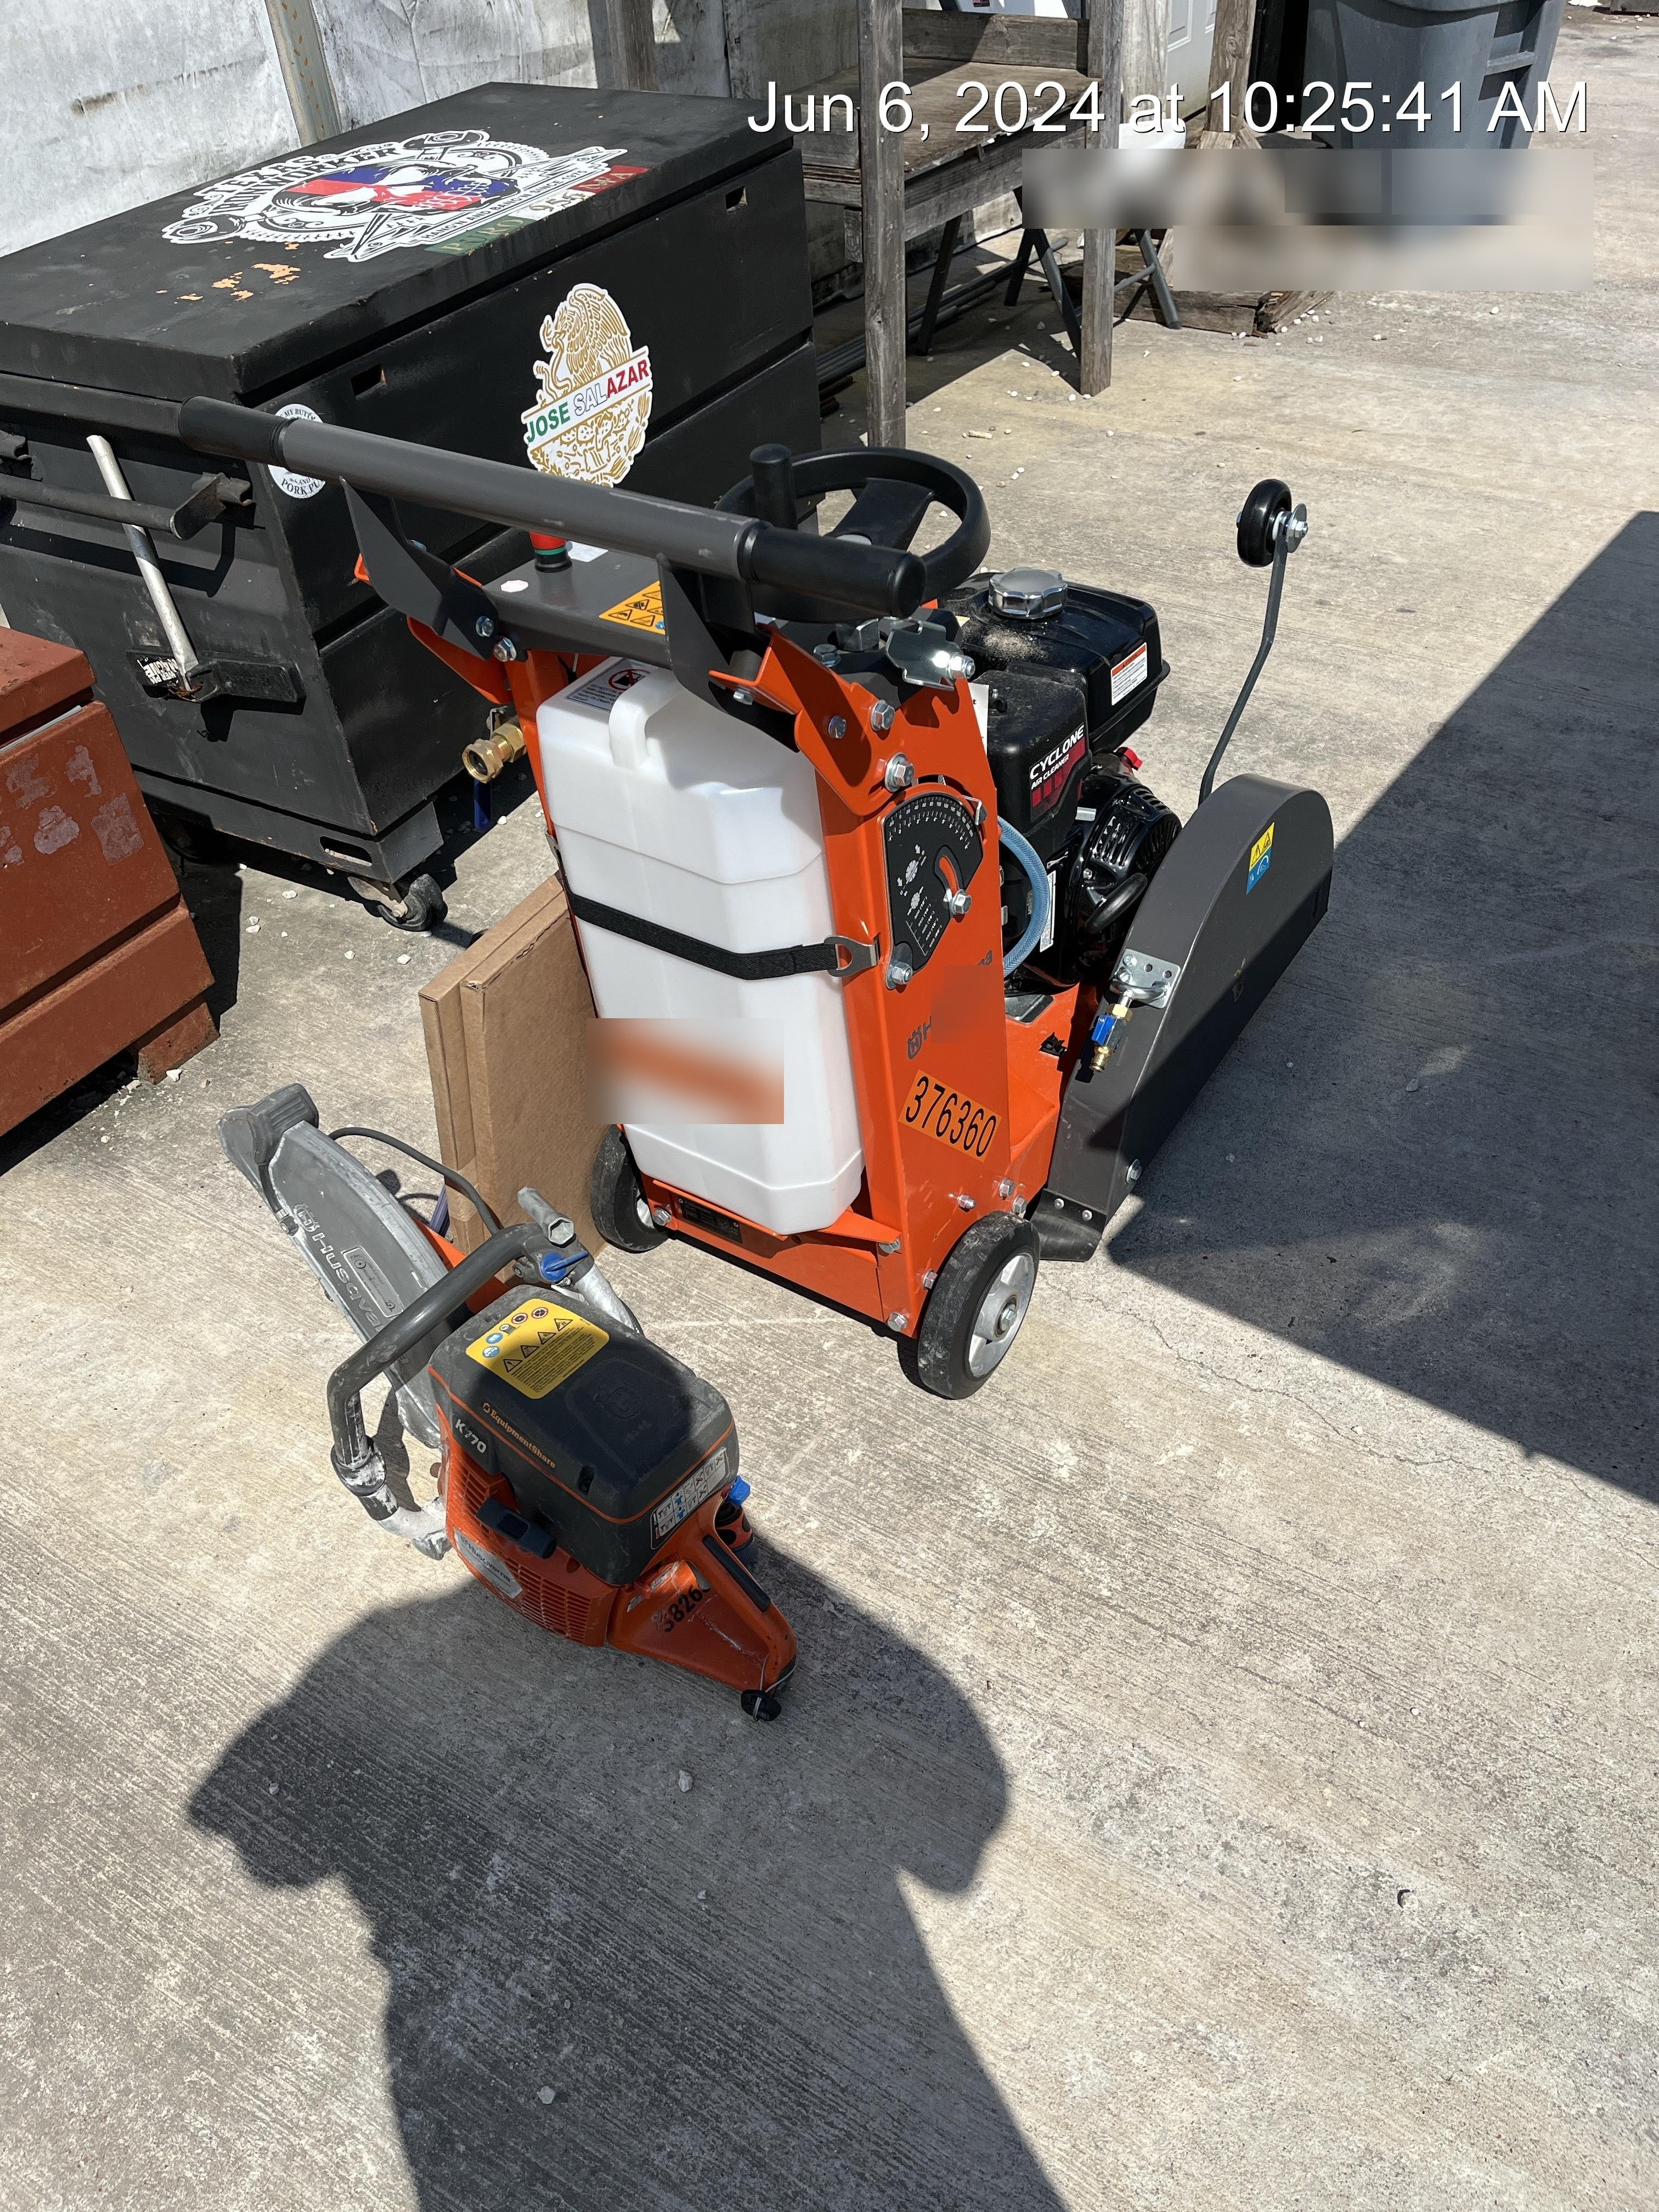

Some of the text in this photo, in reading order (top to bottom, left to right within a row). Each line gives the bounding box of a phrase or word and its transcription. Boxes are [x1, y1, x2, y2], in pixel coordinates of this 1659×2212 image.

[200, 156, 319, 196] TEXAS
[207, 148, 401, 215] IRONWORKER
[466, 211, 492, 221] AND
[529, 180, 564, 193] SINCE
[439, 219, 523, 251] PURO
[284, 409, 294, 417] MY
[526, 359, 650, 443] JOSE SALAZAR
[281, 478, 308, 495] PORK
[1030, 724, 1084, 780] CYCLONE
[1031, 753, 1069, 790] AIR CLEANER
[905, 1076, 997, 1157] 376360
